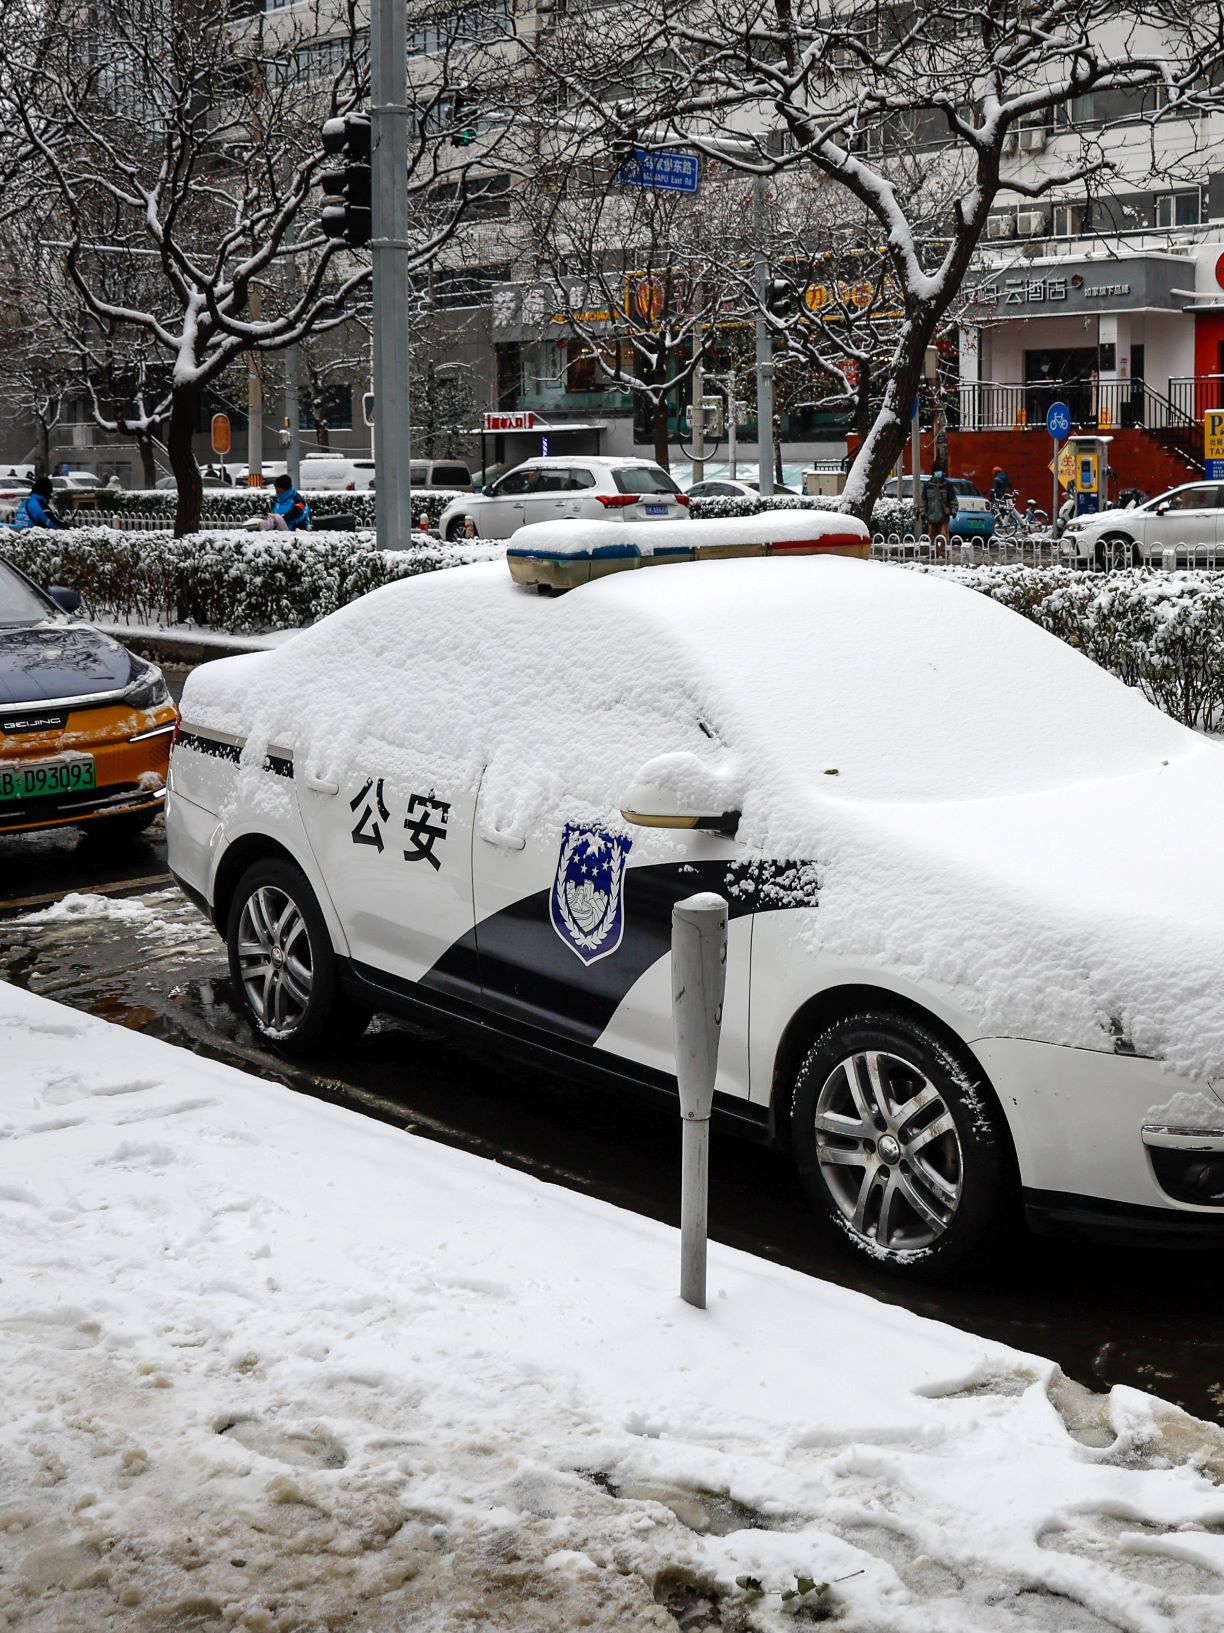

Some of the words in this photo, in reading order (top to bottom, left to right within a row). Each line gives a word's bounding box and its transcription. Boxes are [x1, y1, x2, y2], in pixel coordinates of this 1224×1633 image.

[1210, 415, 1224, 436] P
[4, 717, 61, 729] BEIJING
[0, 762, 94, 797] B·D93093
[349, 777, 452, 872] 公安
